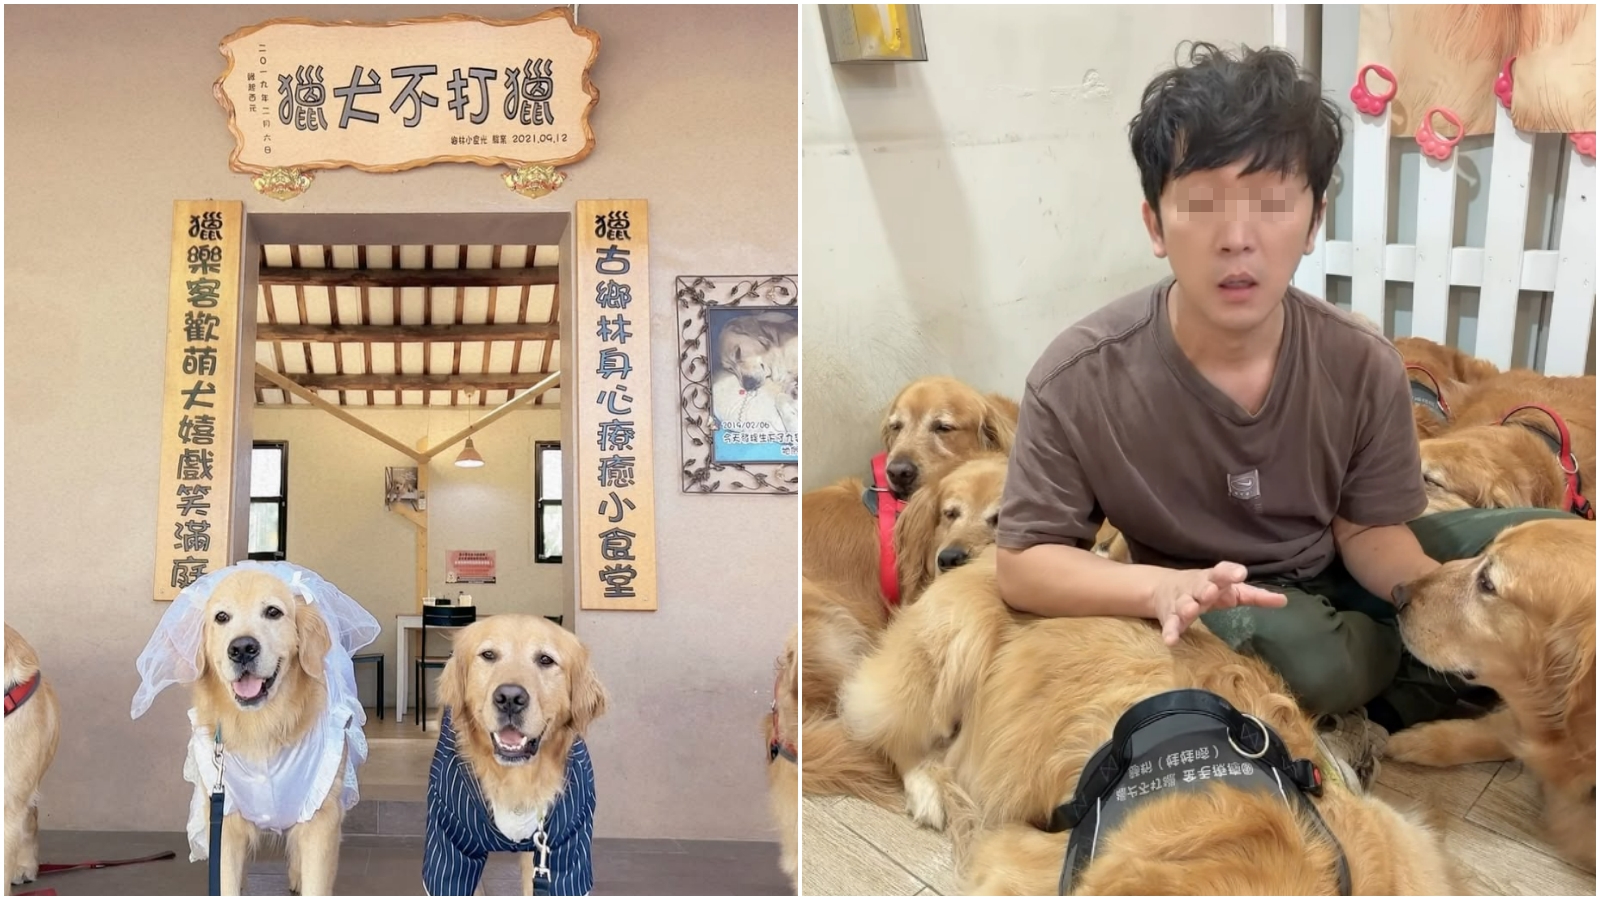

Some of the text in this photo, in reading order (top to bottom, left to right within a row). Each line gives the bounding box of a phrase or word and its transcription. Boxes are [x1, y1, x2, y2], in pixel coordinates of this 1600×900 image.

[277, 58, 555, 131] 獵犬不打獵
[512, 133, 568, 144] 2021.09.12
[171, 211, 223, 589] 獵樂客歡萌犬嬉戲笑滿庭
[595, 211, 637, 597] 獵古鄉林身心療癒小食堂
